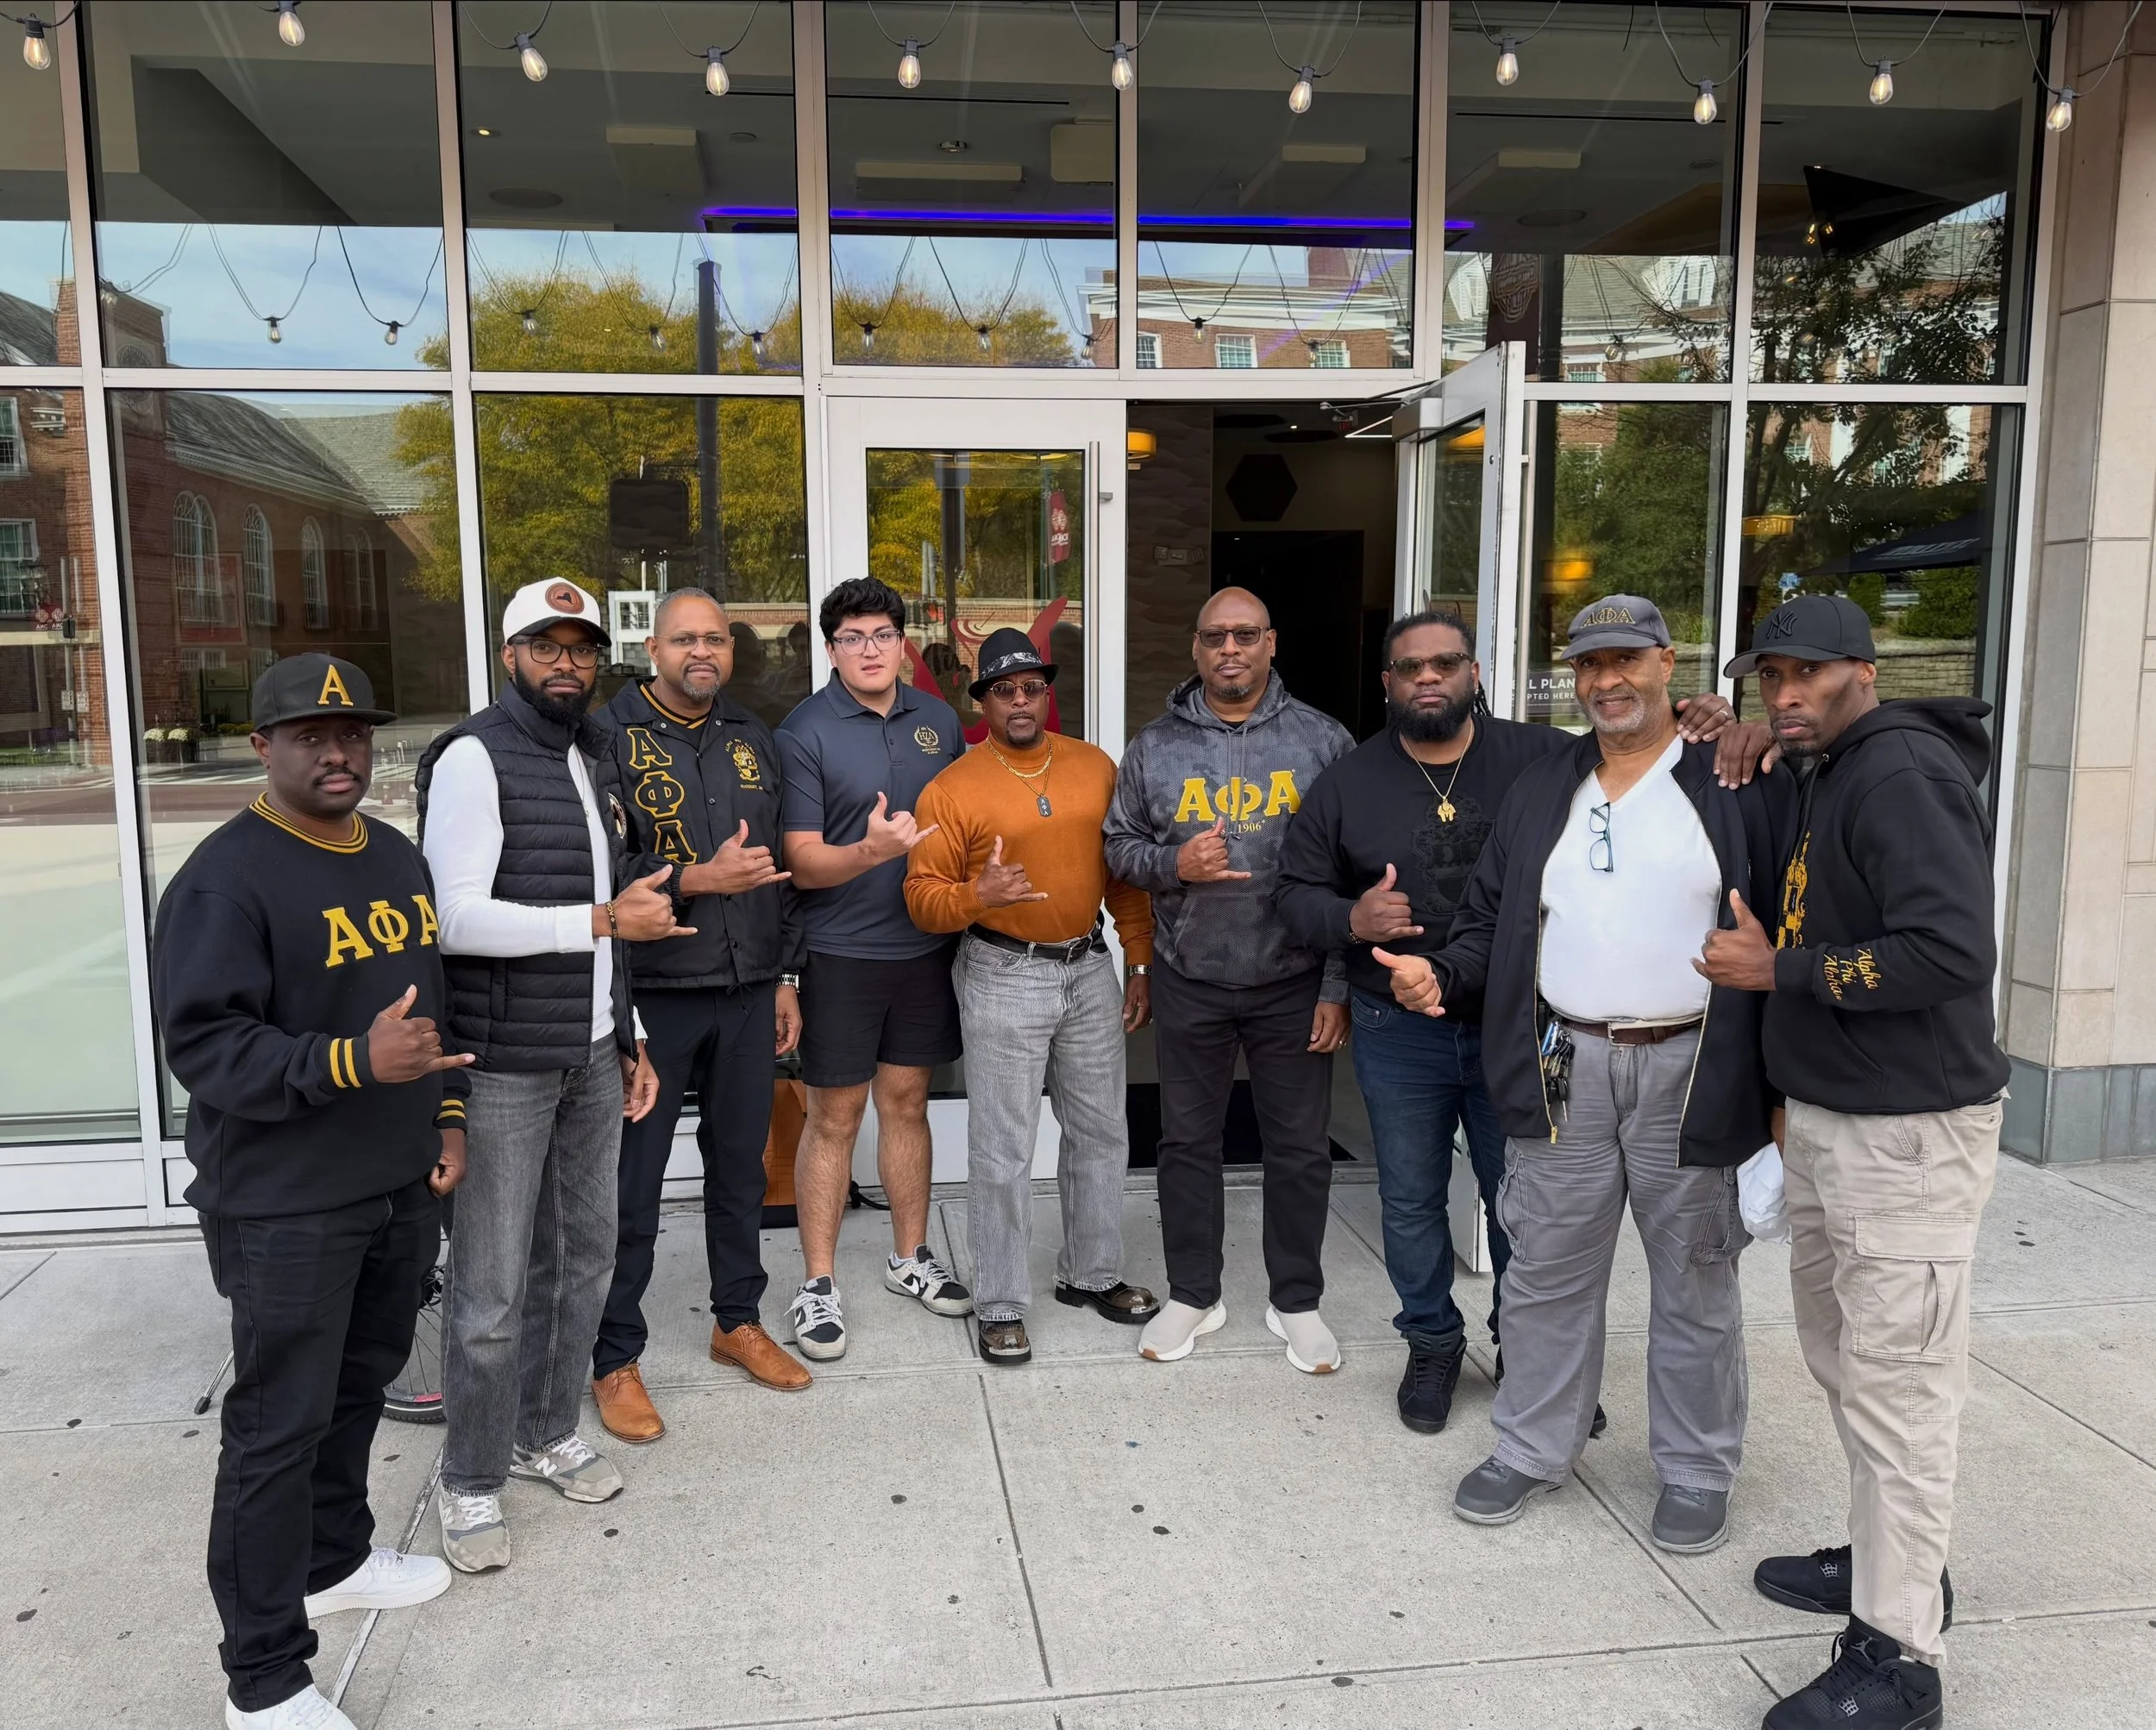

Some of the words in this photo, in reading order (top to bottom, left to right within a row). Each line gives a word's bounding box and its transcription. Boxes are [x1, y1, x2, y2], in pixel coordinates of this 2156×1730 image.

[317, 664, 354, 707] A
[1174, 770, 1301, 823] ΑΦΑ
[1237, 822, 1262, 834] 1906
[321, 894, 441, 968] ΑΦΑ
[1823, 953, 1843, 995] Alpha
[1839, 957, 1858, 984] Phi
[1853, 949, 1882, 990] Alpha
